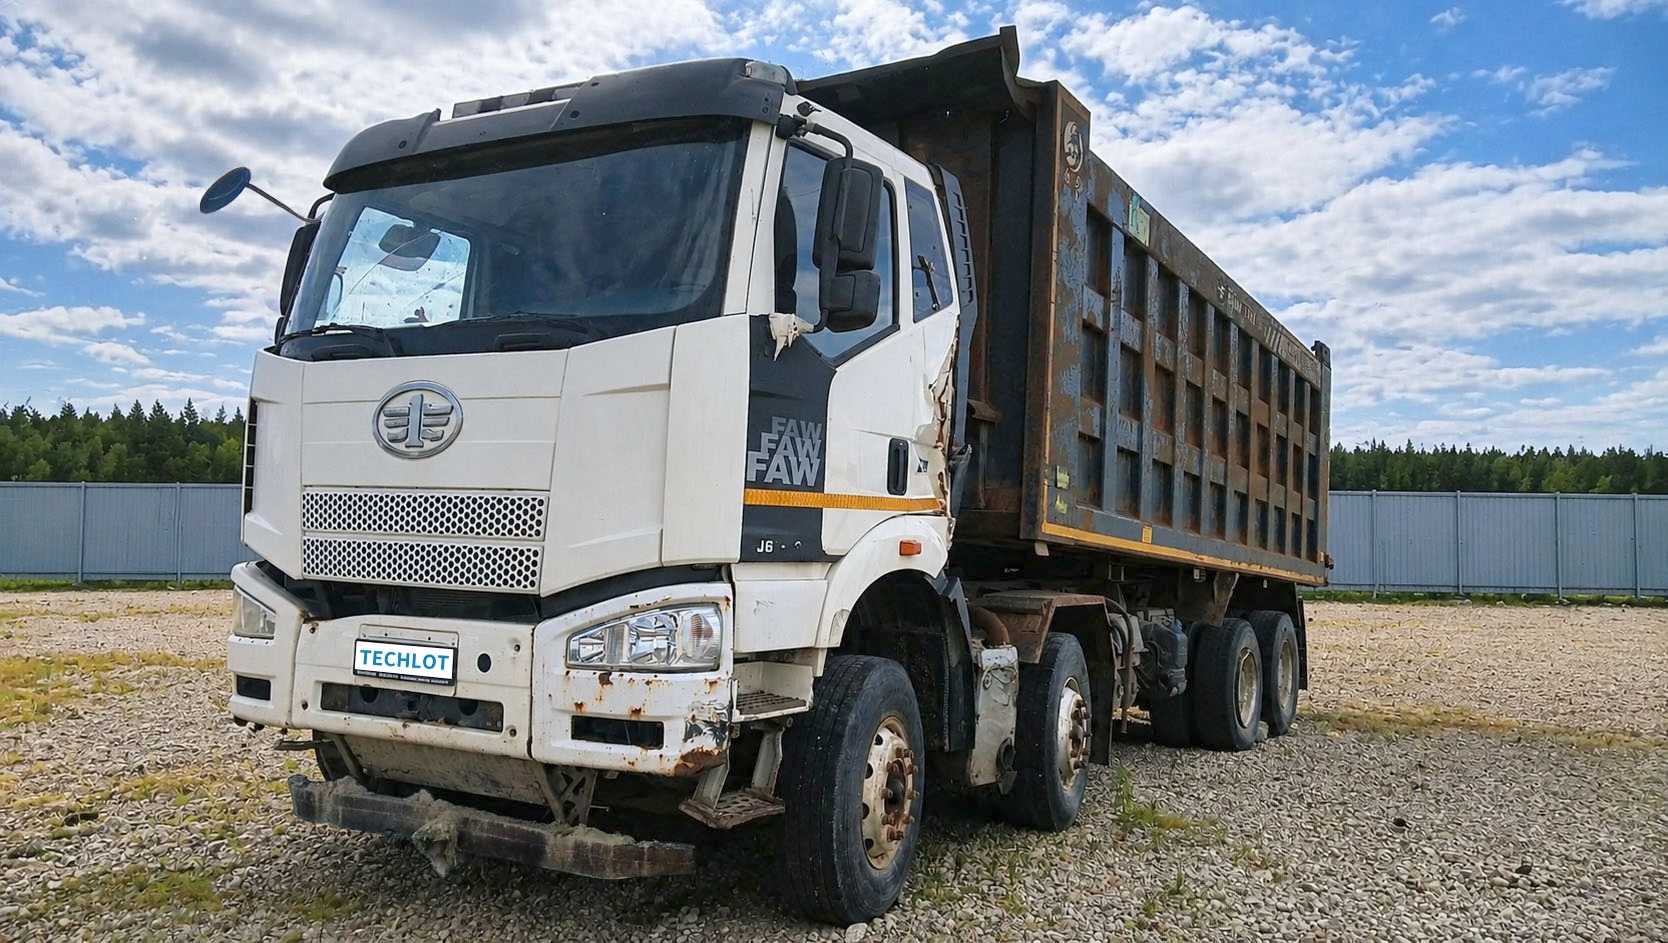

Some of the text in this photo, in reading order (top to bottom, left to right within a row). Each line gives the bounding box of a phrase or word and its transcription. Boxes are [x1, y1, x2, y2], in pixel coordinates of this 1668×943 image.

[771, 416, 822, 444] FAW
[760, 432, 822, 463] FAW
[747, 451, 821, 486] FAW
[360, 649, 449, 670] TECHLOT
